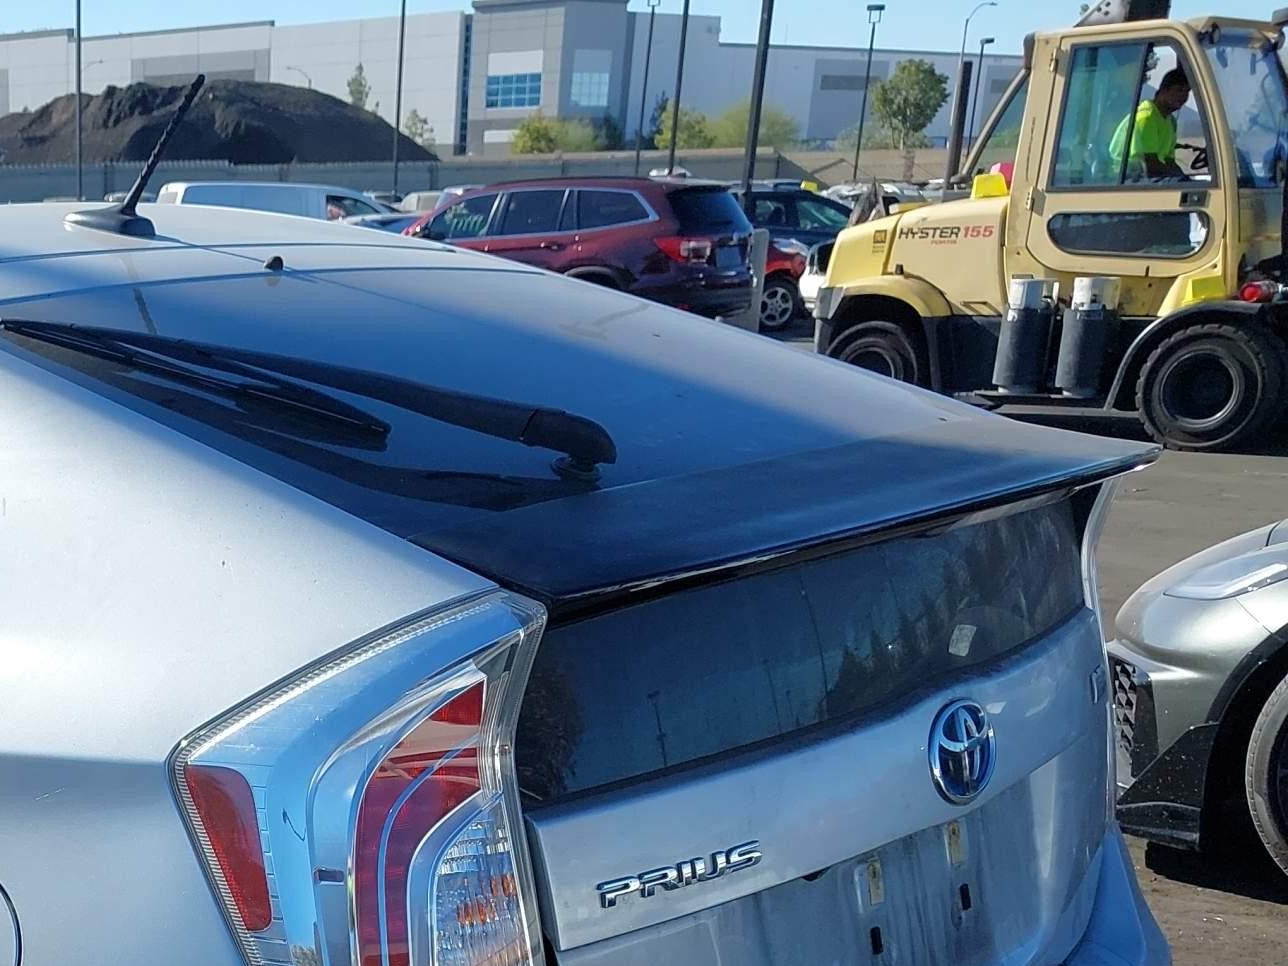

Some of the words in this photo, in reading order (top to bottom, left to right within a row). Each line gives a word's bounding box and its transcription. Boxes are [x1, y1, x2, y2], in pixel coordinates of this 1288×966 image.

[898, 226, 961, 240] HYSTER
[963, 225, 995, 239] 155
[596, 839, 763, 910] PRIUS
